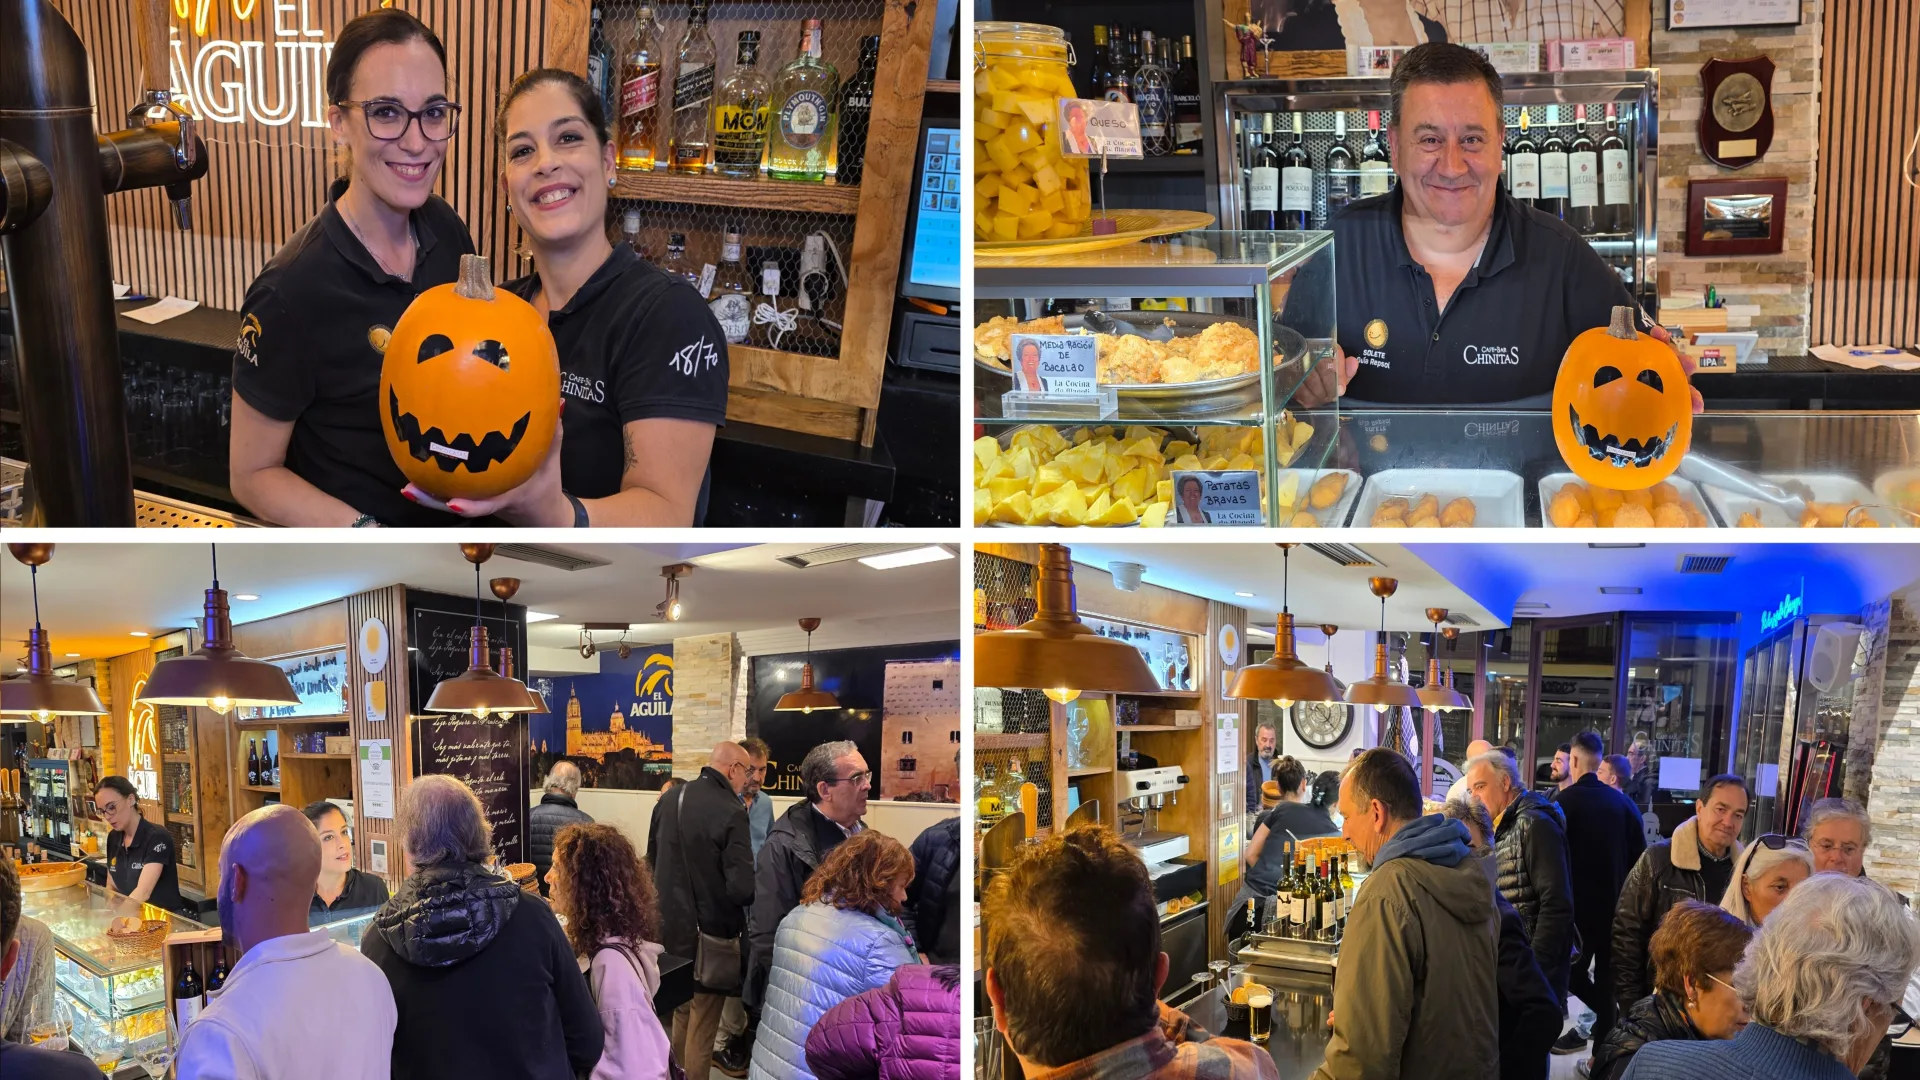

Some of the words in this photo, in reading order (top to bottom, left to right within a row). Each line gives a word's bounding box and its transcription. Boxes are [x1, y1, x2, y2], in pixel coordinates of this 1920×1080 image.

[274, 0, 324, 36] EL
[783, 92, 820, 121] PLYMOUTH
[723, 112, 768, 131] MOM
[1090, 116, 1127, 129] QUESO
[669, 335, 719, 377] 18/70
[1058, 351, 1070, 360] DE
[1363, 349, 1386, 359] SOLETE
[1463, 344, 1519, 365] CHINITAS
[1369, 358, 1391, 369] Repsol
[1217, 512, 1227, 520] La
[1229, 512, 1255, 520] Cocina
[653, 691, 663, 701] EL
[1633, 730, 1700, 753] CHINITAS
